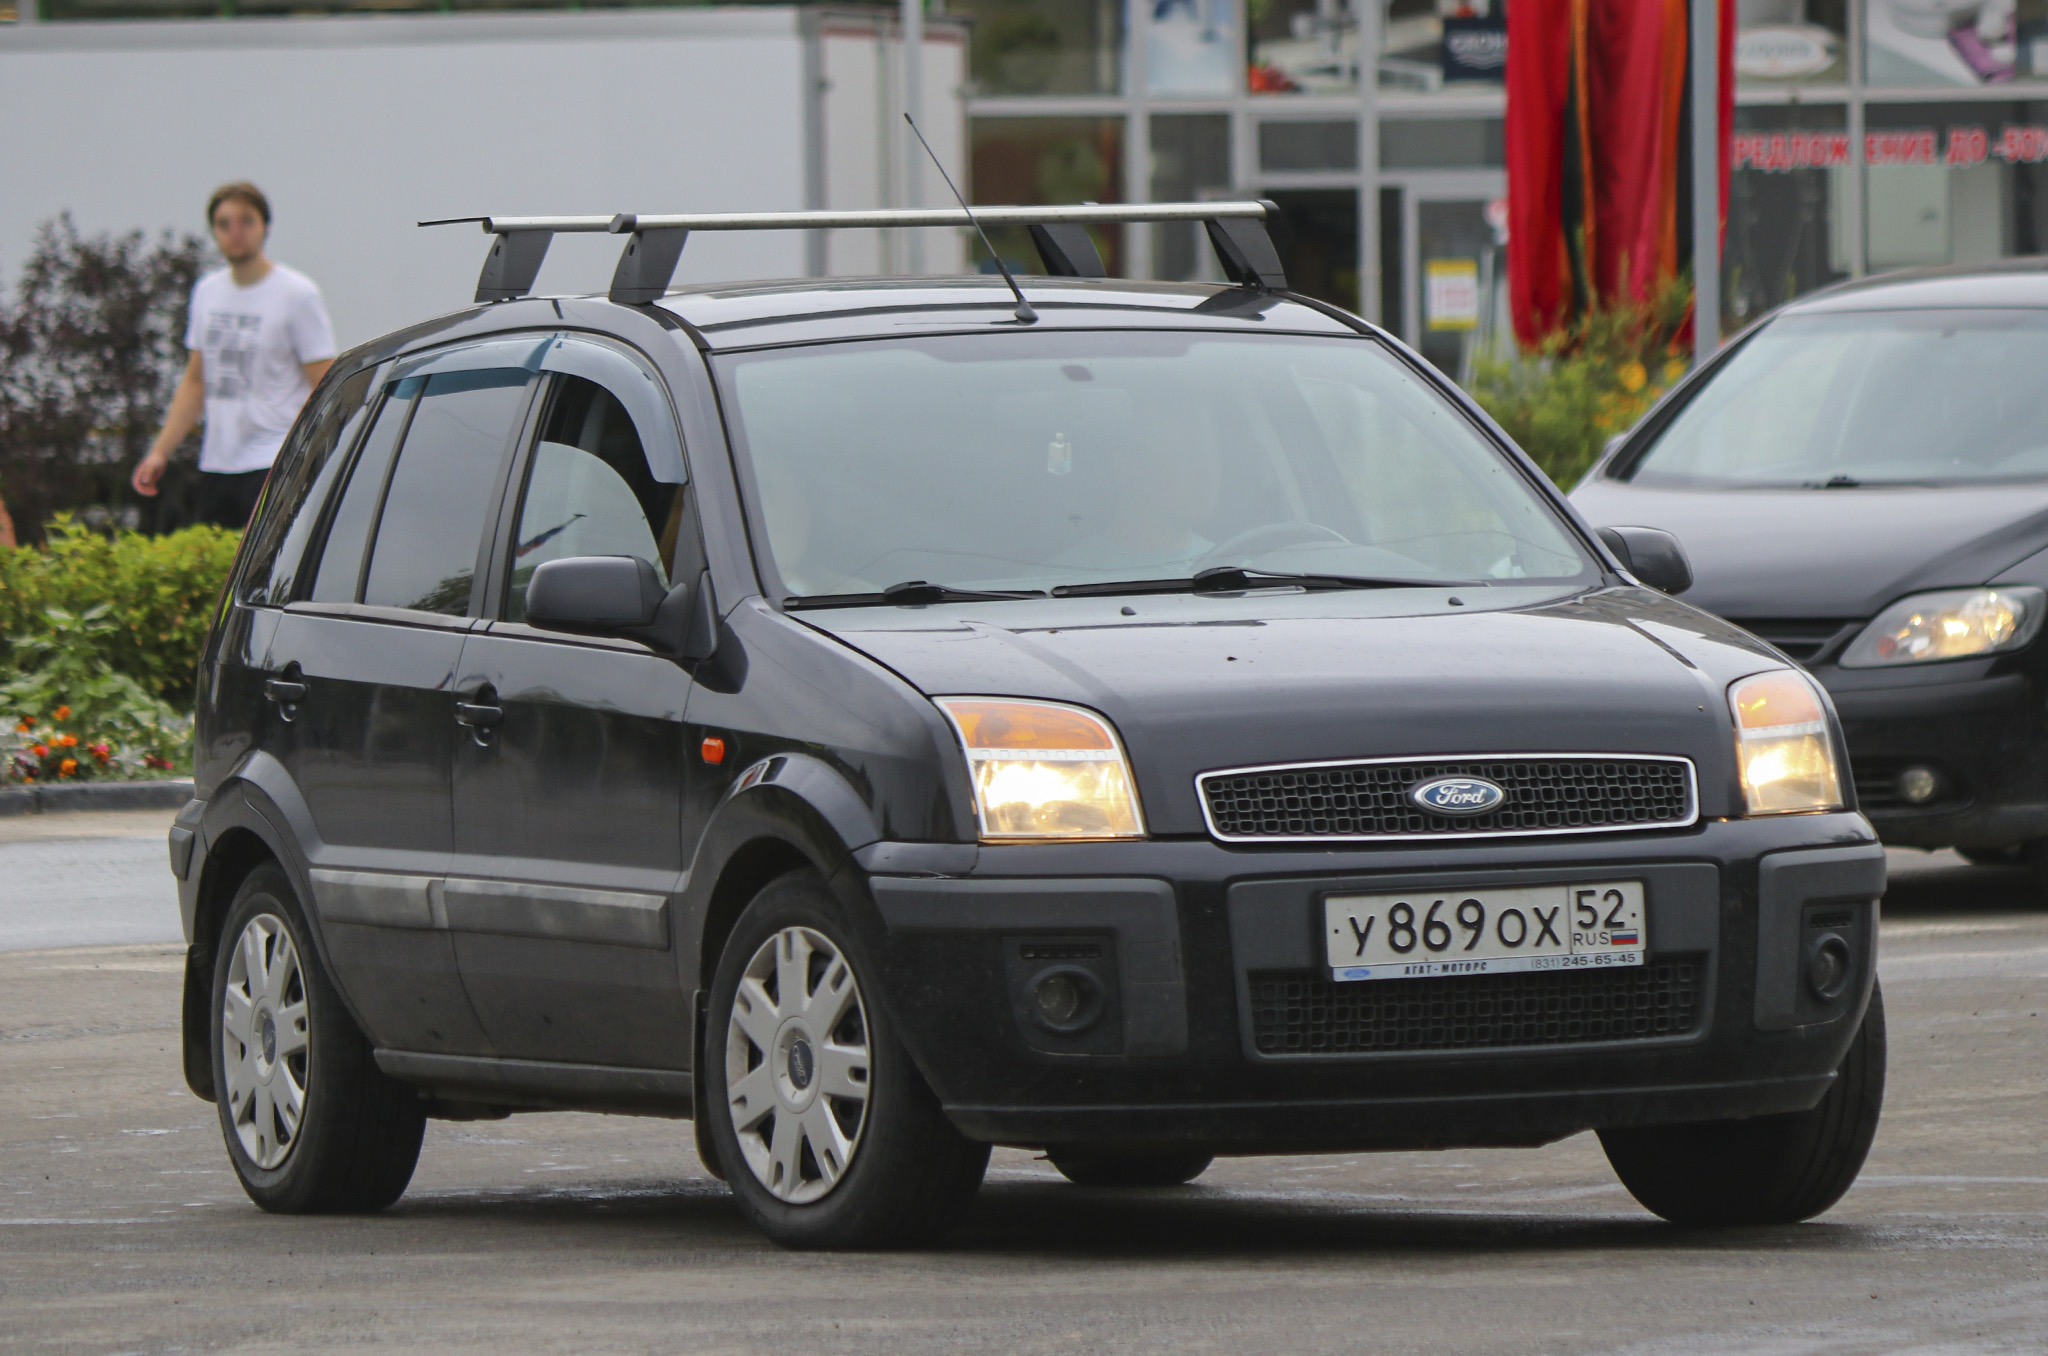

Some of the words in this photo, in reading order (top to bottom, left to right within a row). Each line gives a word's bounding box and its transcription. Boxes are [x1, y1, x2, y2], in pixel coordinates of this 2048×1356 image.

[1734, 131, 1938, 172] РЕДЛОЖЕНИЕ
[1436, 784, 1487, 805] Ford
[1575, 889, 1626, 929] 52
[1573, 932, 1609, 946] RUS
[1531, 957, 1560, 970] (831)
[1562, 953, 1636, 967] 245-65-45
